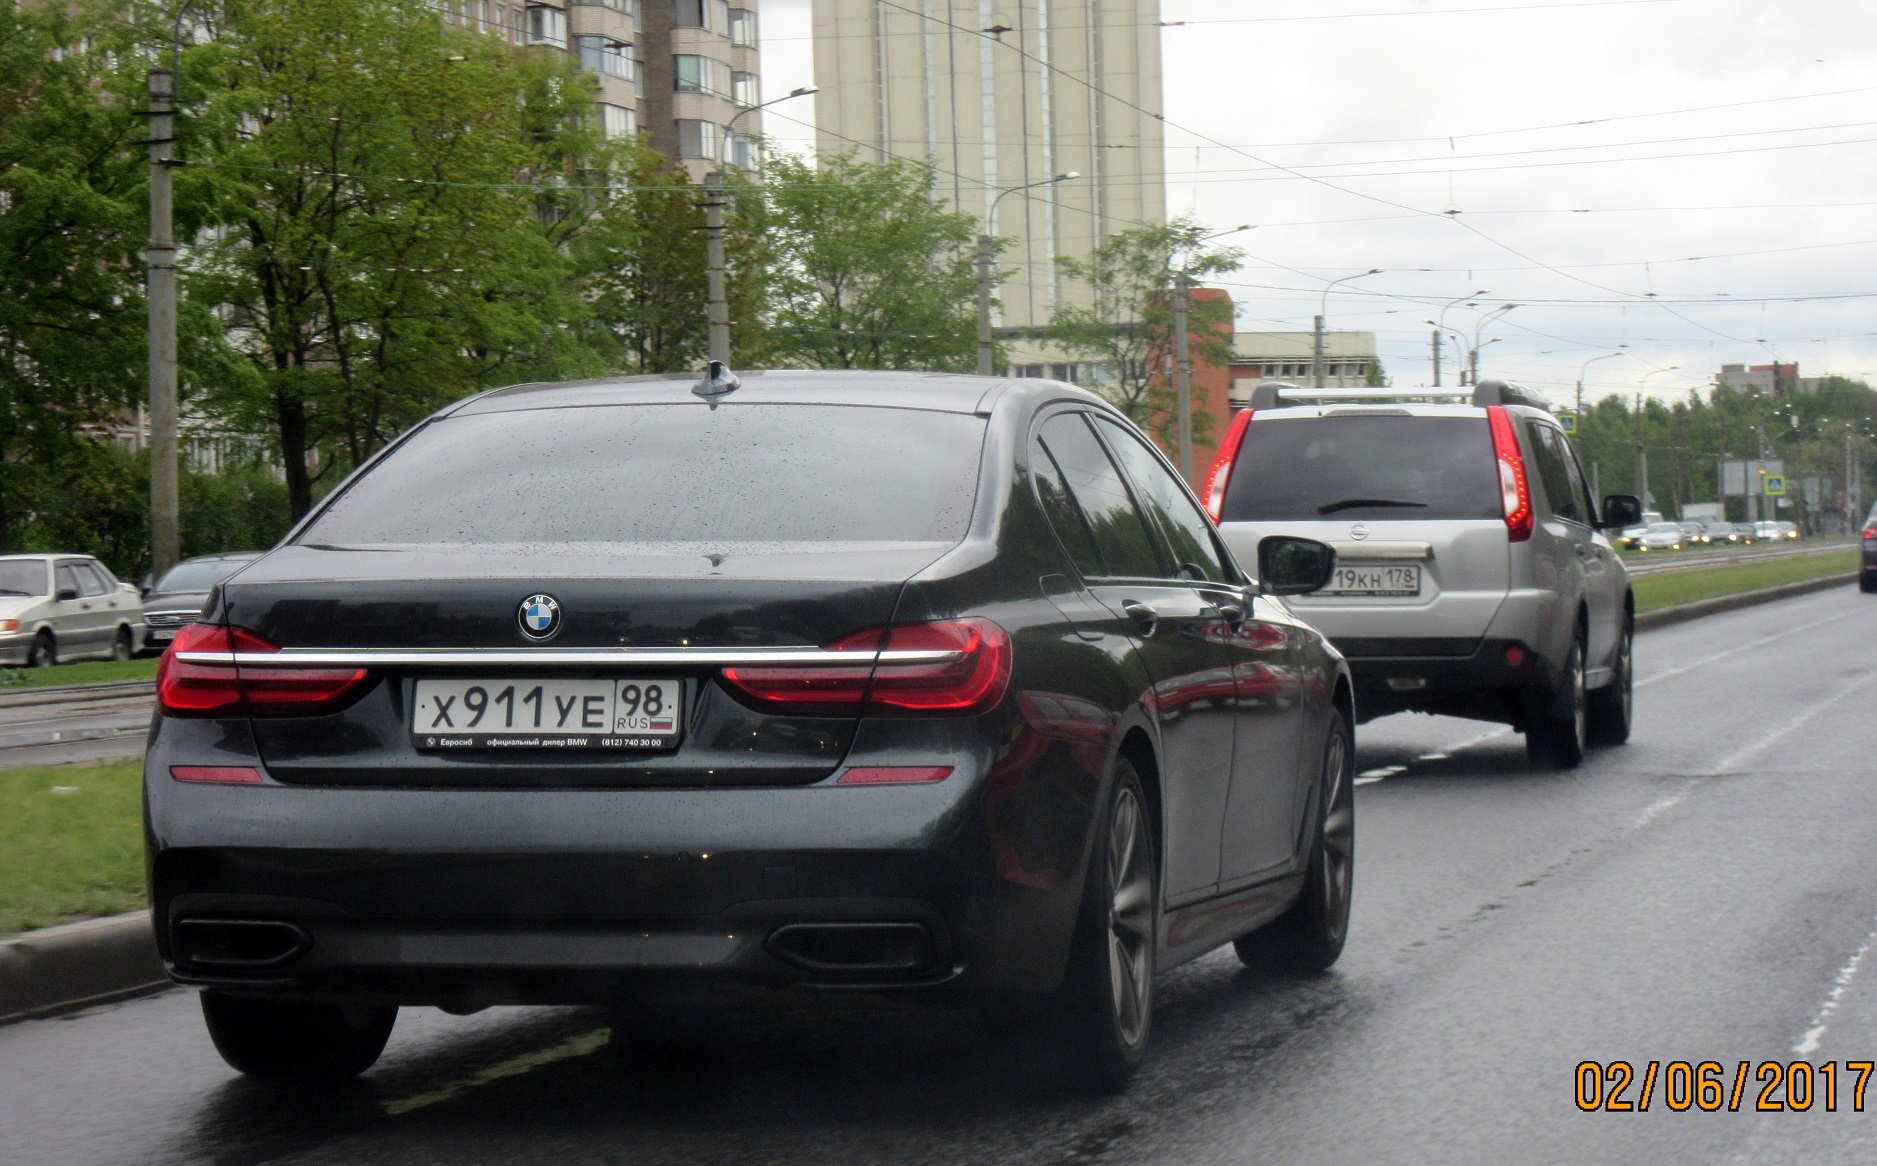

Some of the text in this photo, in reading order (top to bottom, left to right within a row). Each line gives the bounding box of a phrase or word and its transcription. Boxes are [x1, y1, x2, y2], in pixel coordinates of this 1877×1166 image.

[1385, 569, 1413, 583] 178
[523, 596, 557, 610] BMW
[431, 684, 663, 728] Х911УЕ 98
[616, 717, 649, 729] RUS
[440, 738, 662, 748] Евросиб официальный дилер BMW (812) 740 30 00
